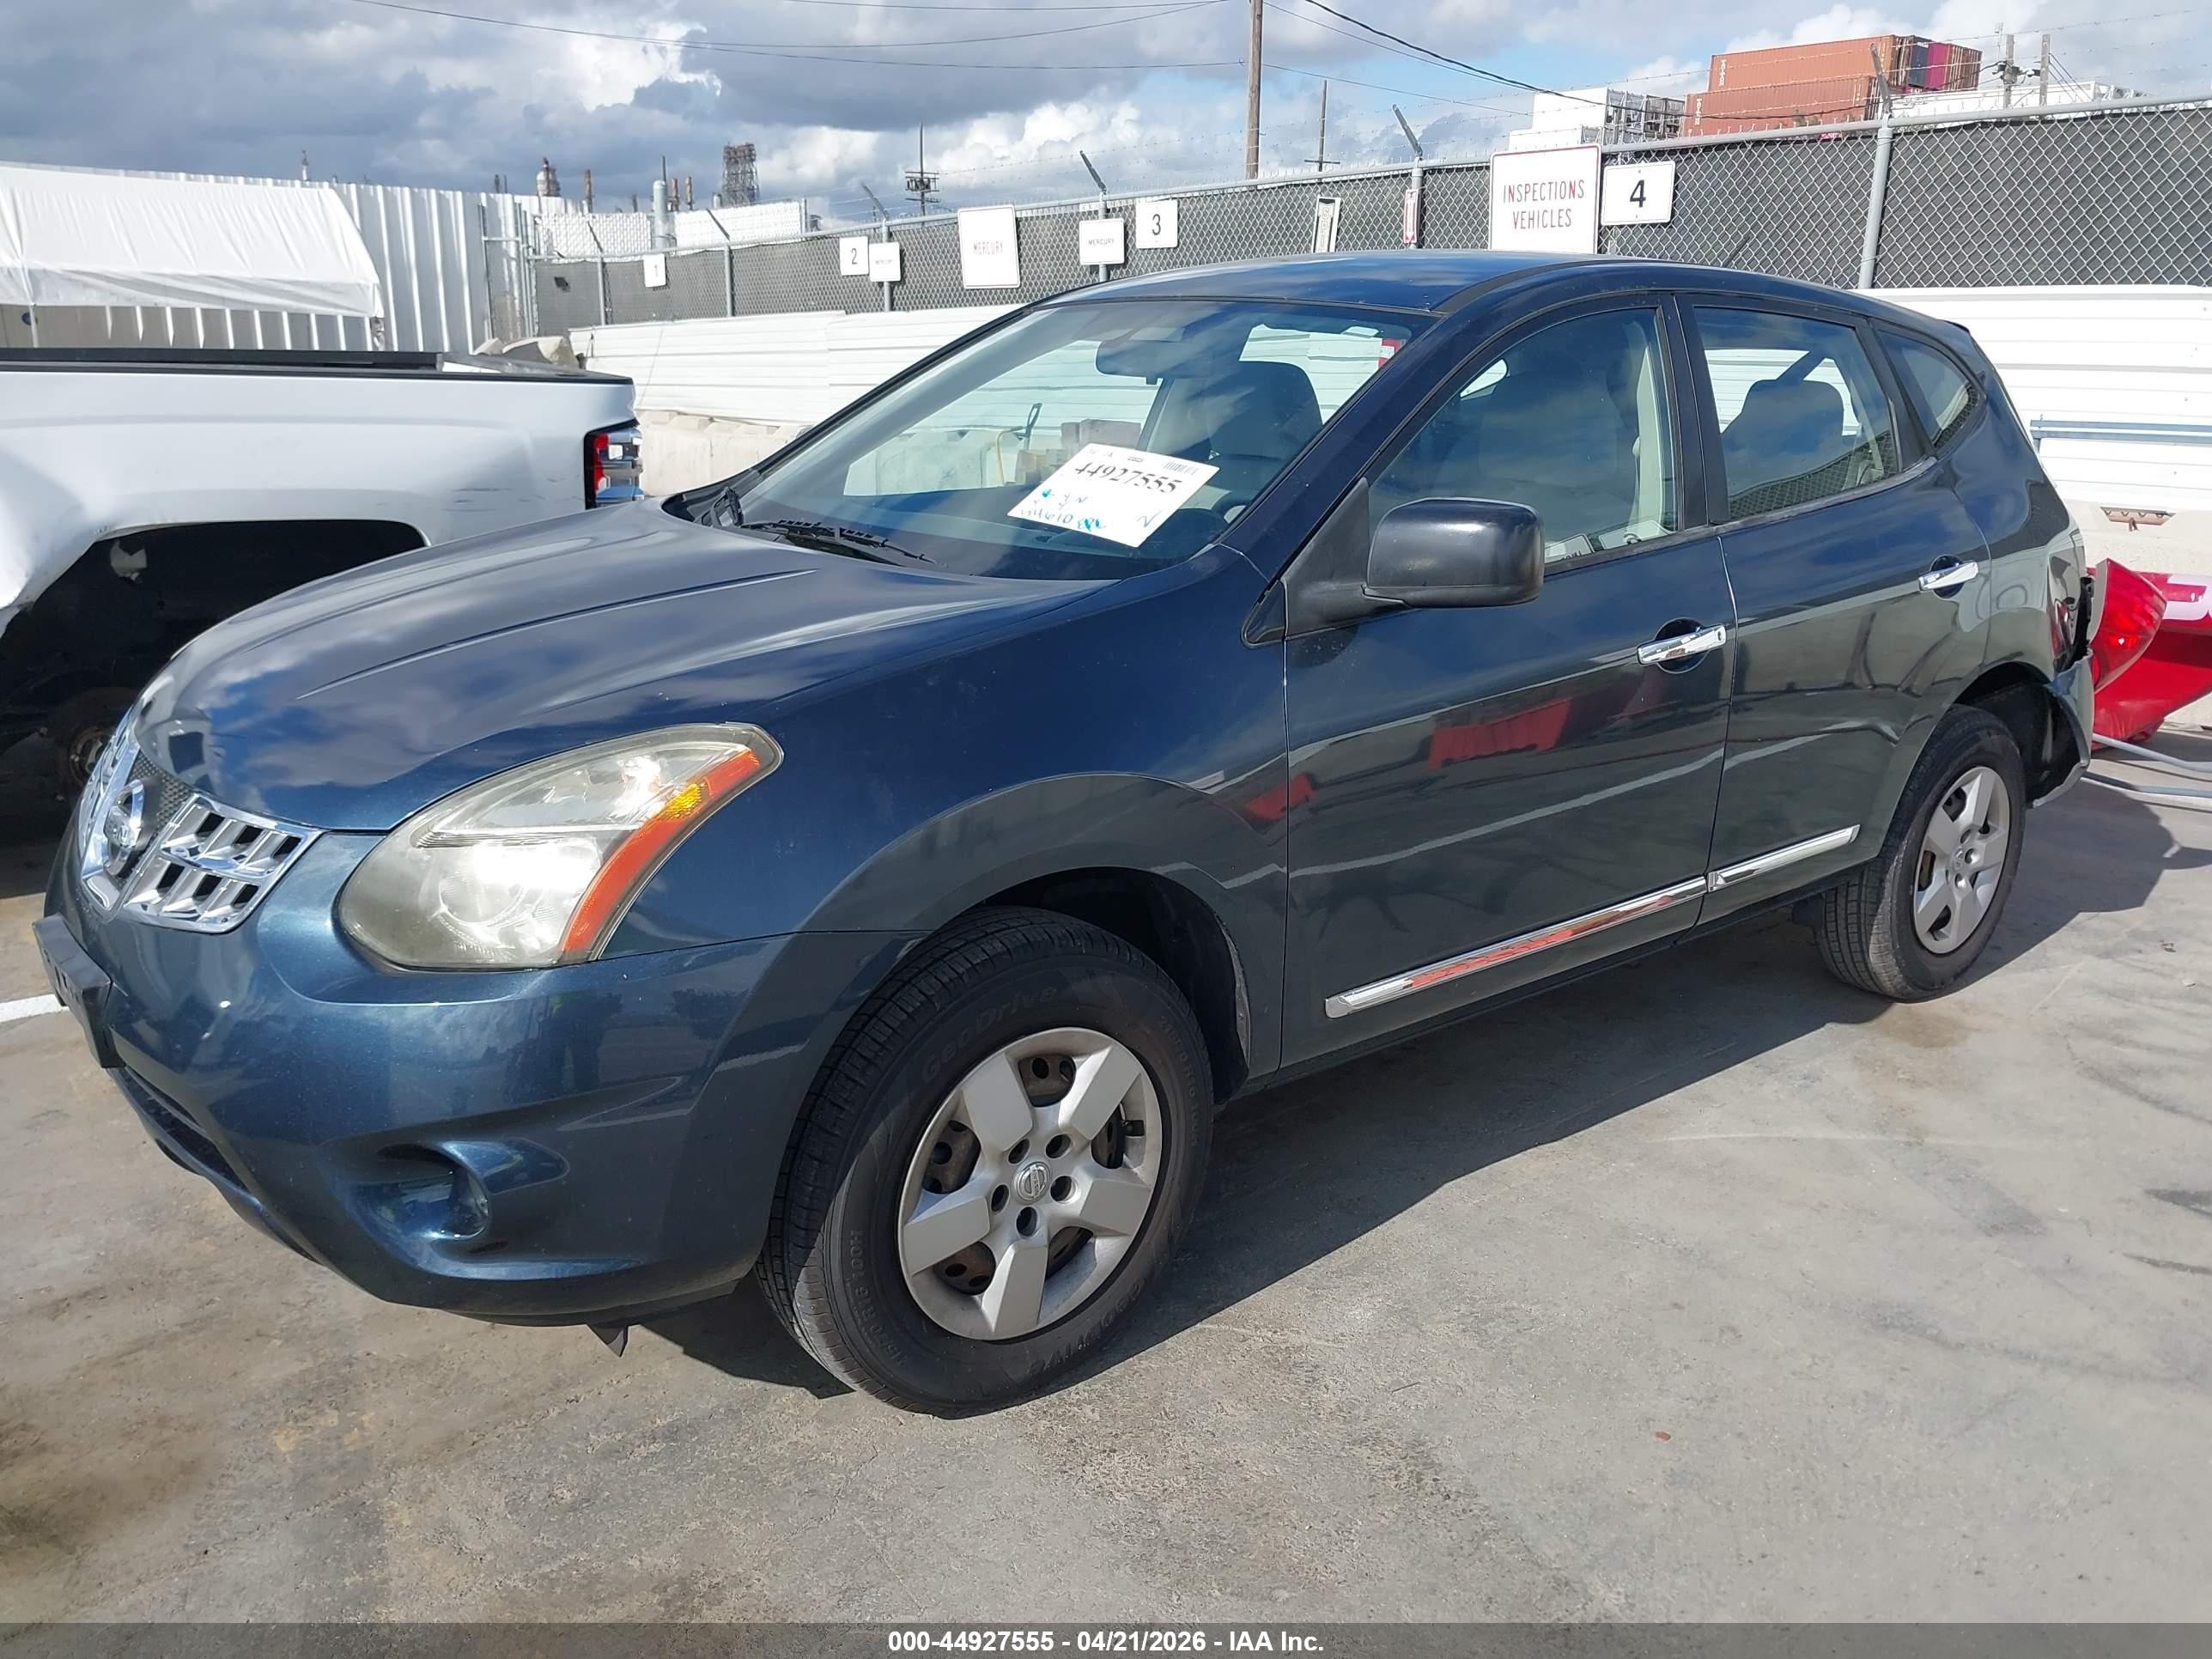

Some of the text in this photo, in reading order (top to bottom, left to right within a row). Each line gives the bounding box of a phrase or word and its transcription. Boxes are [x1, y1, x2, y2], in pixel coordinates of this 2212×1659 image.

[1503, 179, 1585, 204] INSPECTIONS
[1630, 179, 1647, 208] 4
[1152, 214, 1161, 235] 3
[1512, 209, 1572, 229] VEHICLES
[851, 247, 858, 265] 2
[974, 241, 1003, 255] MERCURY
[1074, 462, 1183, 493] 44927555
